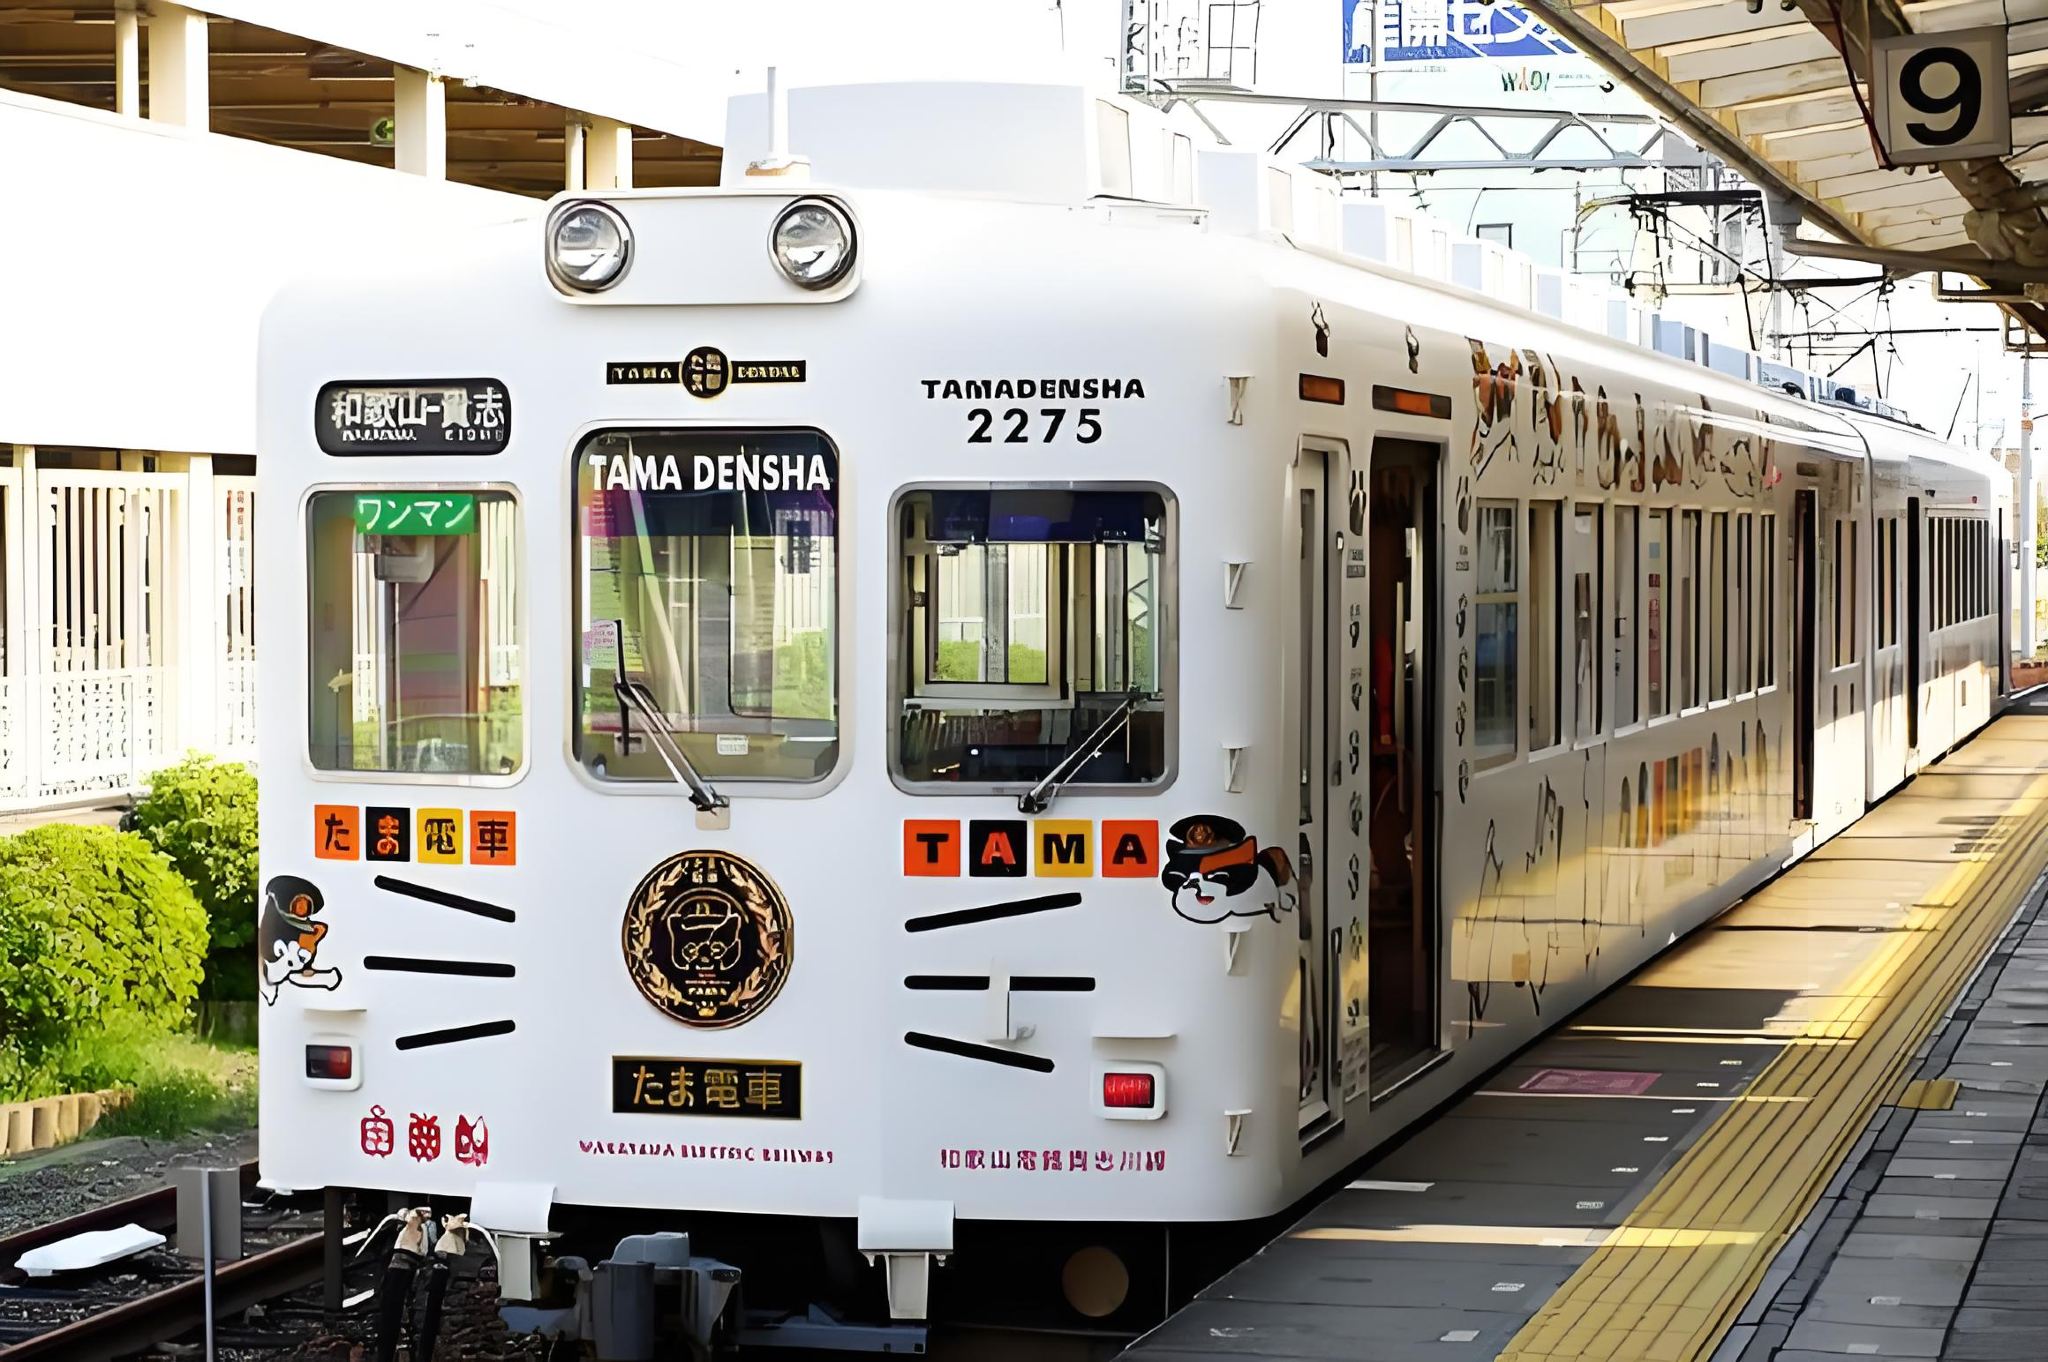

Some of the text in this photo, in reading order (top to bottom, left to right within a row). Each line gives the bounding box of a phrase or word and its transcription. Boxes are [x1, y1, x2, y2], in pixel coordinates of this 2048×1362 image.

[1899, 47, 1982, 146] 9
[921, 379, 1145, 399] TAMADENSHA
[967, 408, 1102, 444] 2275
[588, 454, 831, 491] TAMA DENSHA
[358, 499, 471, 530] ワンマン
[916, 831, 1148, 865] TAMA
[633, 1065, 783, 1111] たま電車
